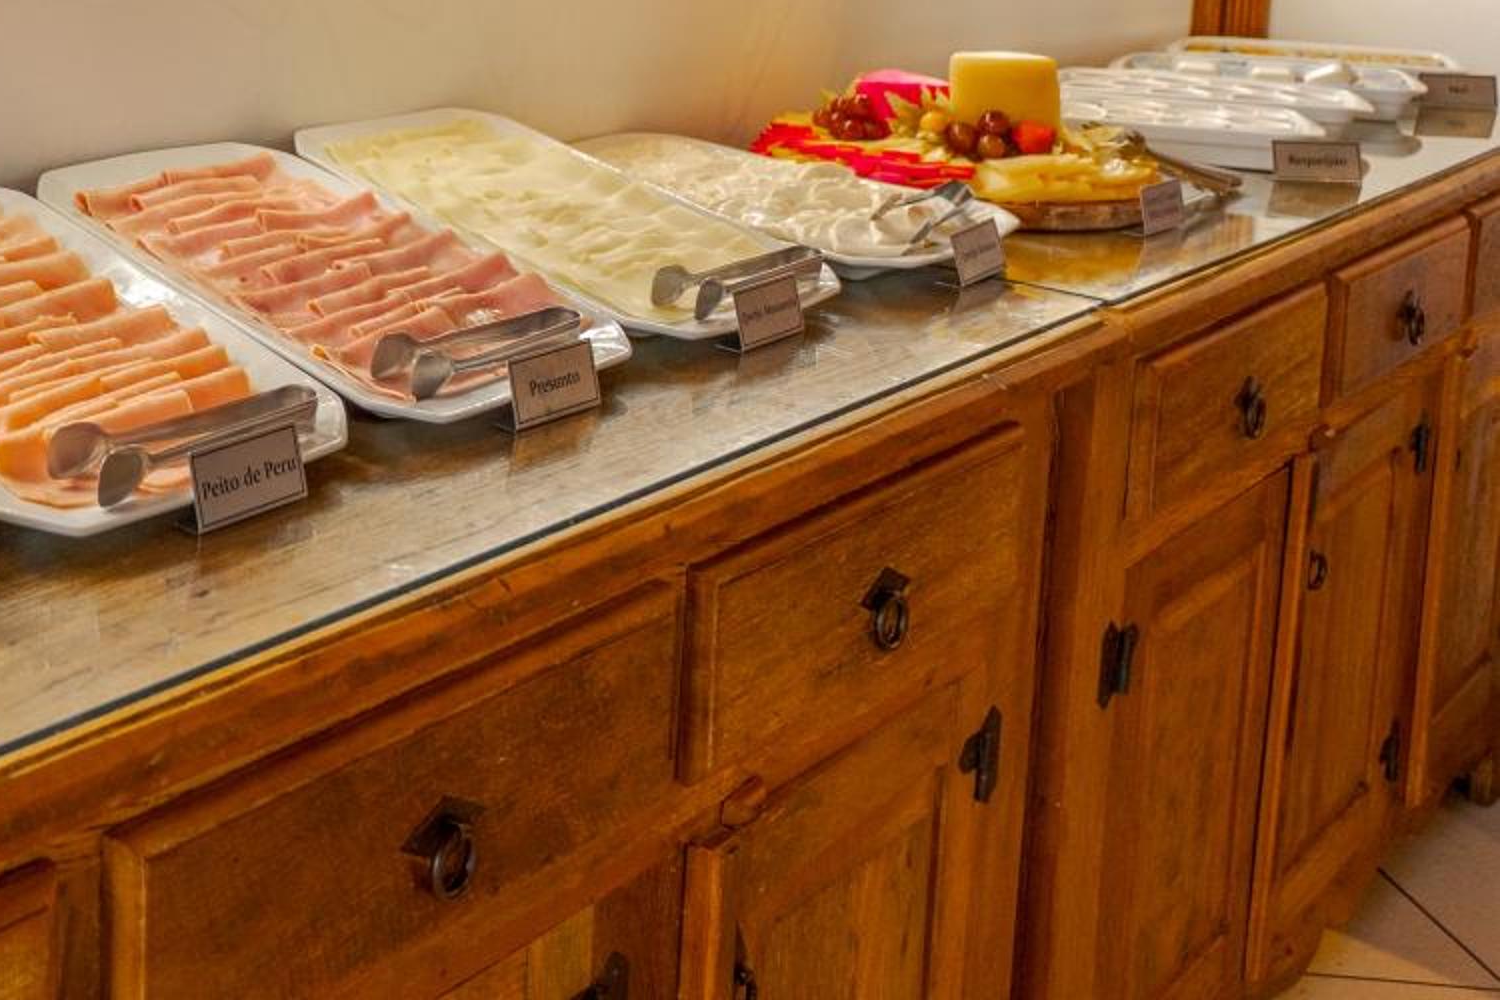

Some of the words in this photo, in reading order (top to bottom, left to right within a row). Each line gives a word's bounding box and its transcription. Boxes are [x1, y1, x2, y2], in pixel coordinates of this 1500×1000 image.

[201, 474, 239, 500] Peito
[244, 466, 261, 487] de
[263, 457, 298, 480] Peru
